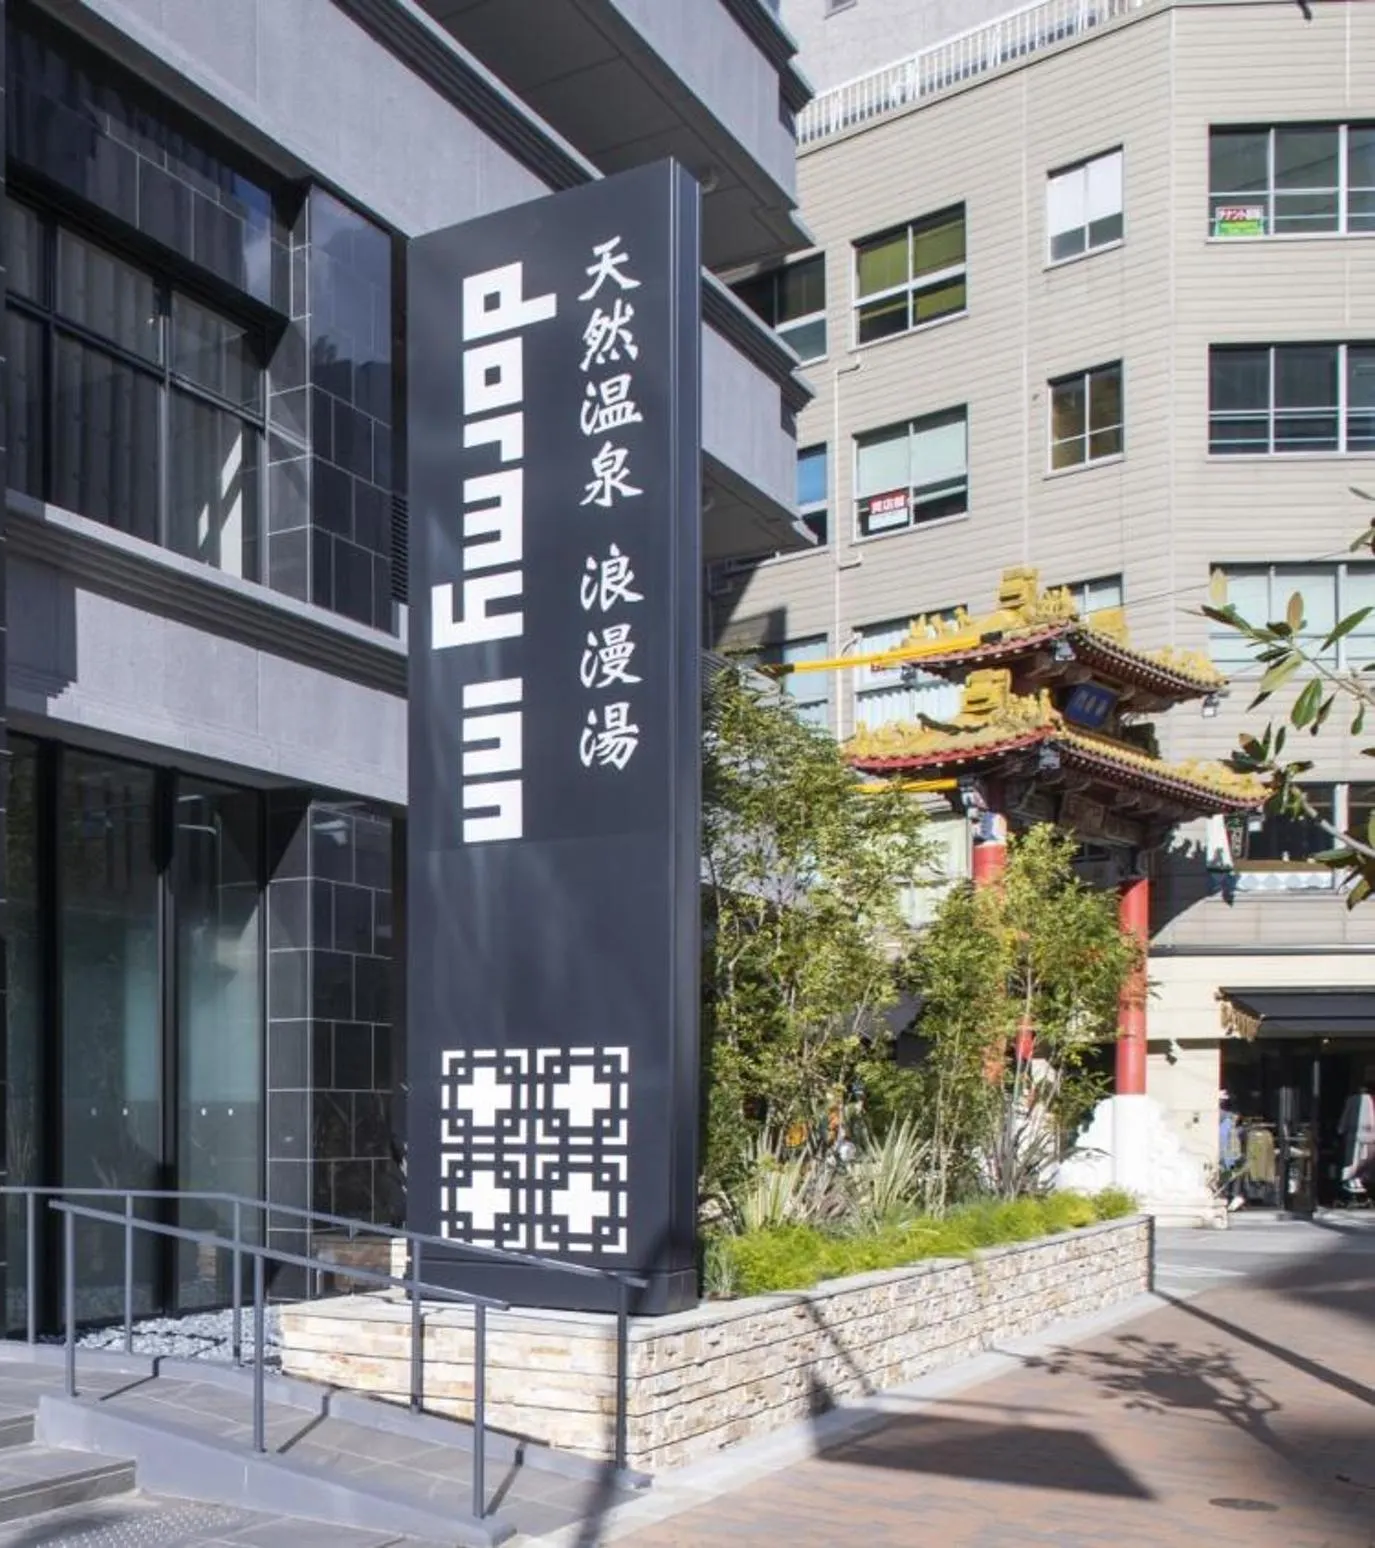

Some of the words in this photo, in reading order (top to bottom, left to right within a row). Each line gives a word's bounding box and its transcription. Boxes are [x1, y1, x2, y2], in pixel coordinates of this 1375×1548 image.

[431, 261, 557, 650] dormy
[577, 235, 644, 507] 天然温泉
[462, 677, 523, 843] inn
[578, 542, 645, 770] 浪漫湯
